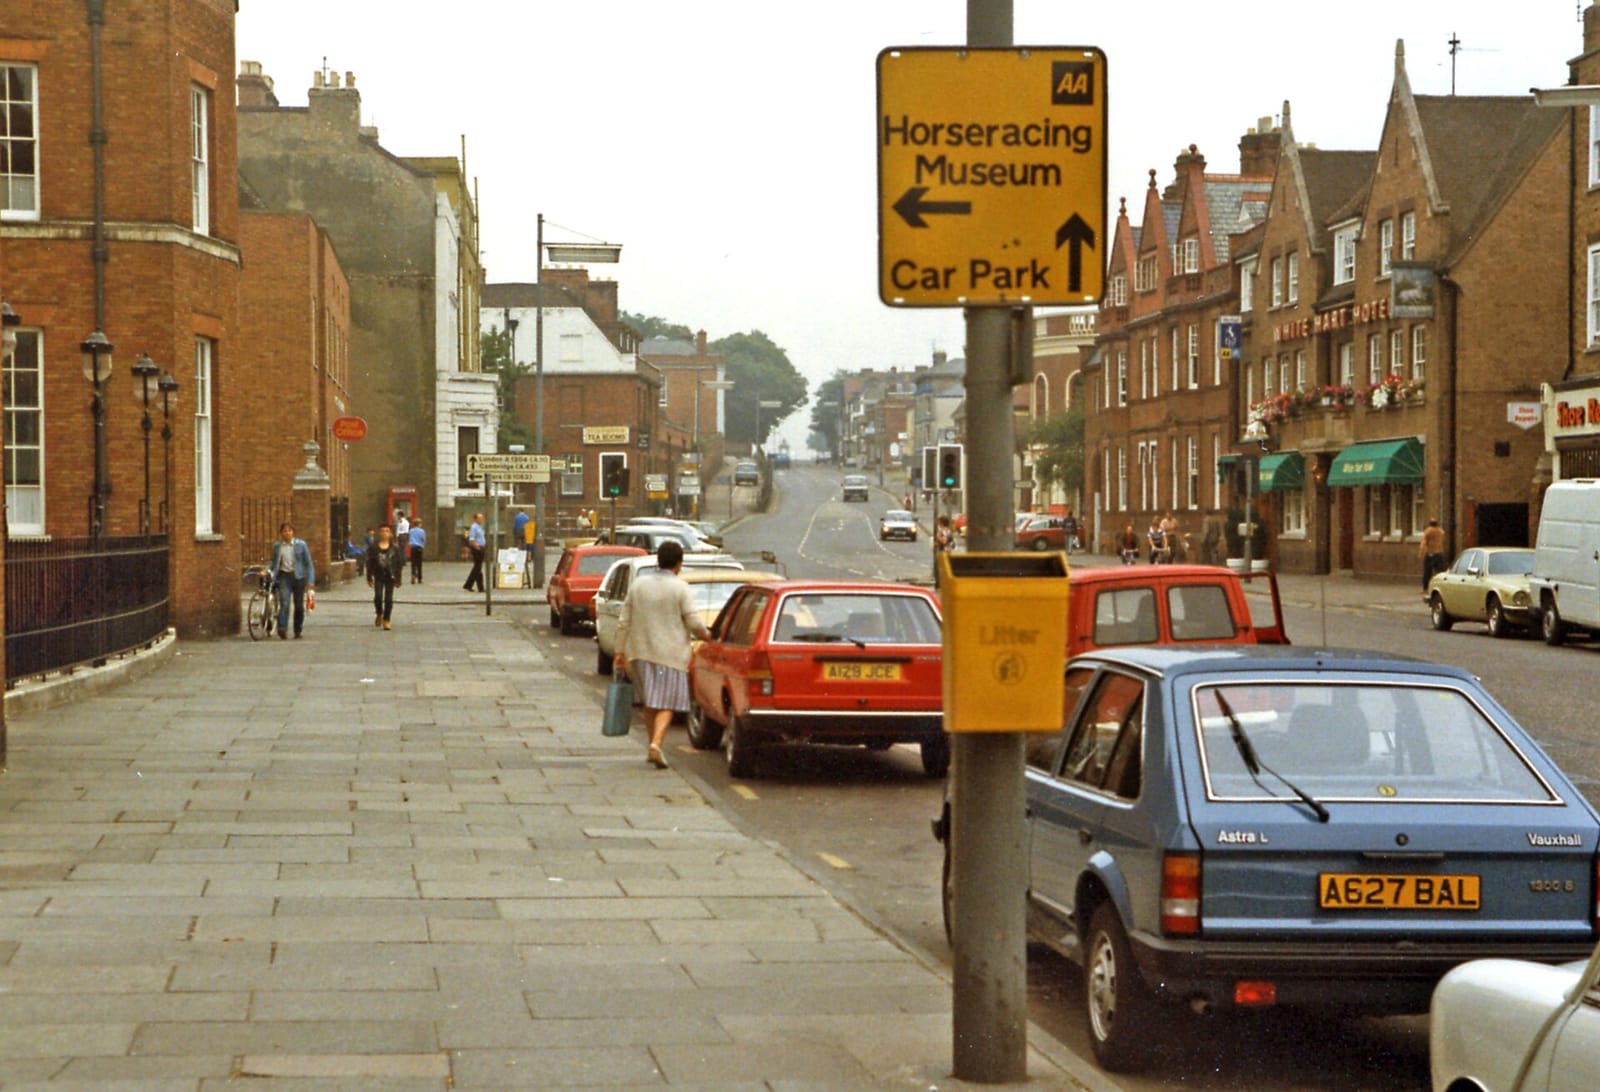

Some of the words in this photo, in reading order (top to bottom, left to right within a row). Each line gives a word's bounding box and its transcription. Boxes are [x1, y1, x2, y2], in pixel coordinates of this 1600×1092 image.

[1056, 73, 1088, 94] AA
[884, 115, 1092, 154] Horseracing
[915, 155, 1062, 186] Museum
[891, 259, 956, 290] Car
[969, 259, 1050, 289] Park
[1273, 317, 1309, 342] WHITE
[1314, 307, 1348, 333] HART
[1556, 401, 1583, 428] Shoe
[865, 665, 894, 679] JCE
[1218, 830, 1256, 843] Astra
[1260, 832, 1269, 843] L
[1527, 832, 1582, 847] Vauxhall
[1323, 878, 1406, 905] A627
[1415, 879, 1478, 906] BAL
